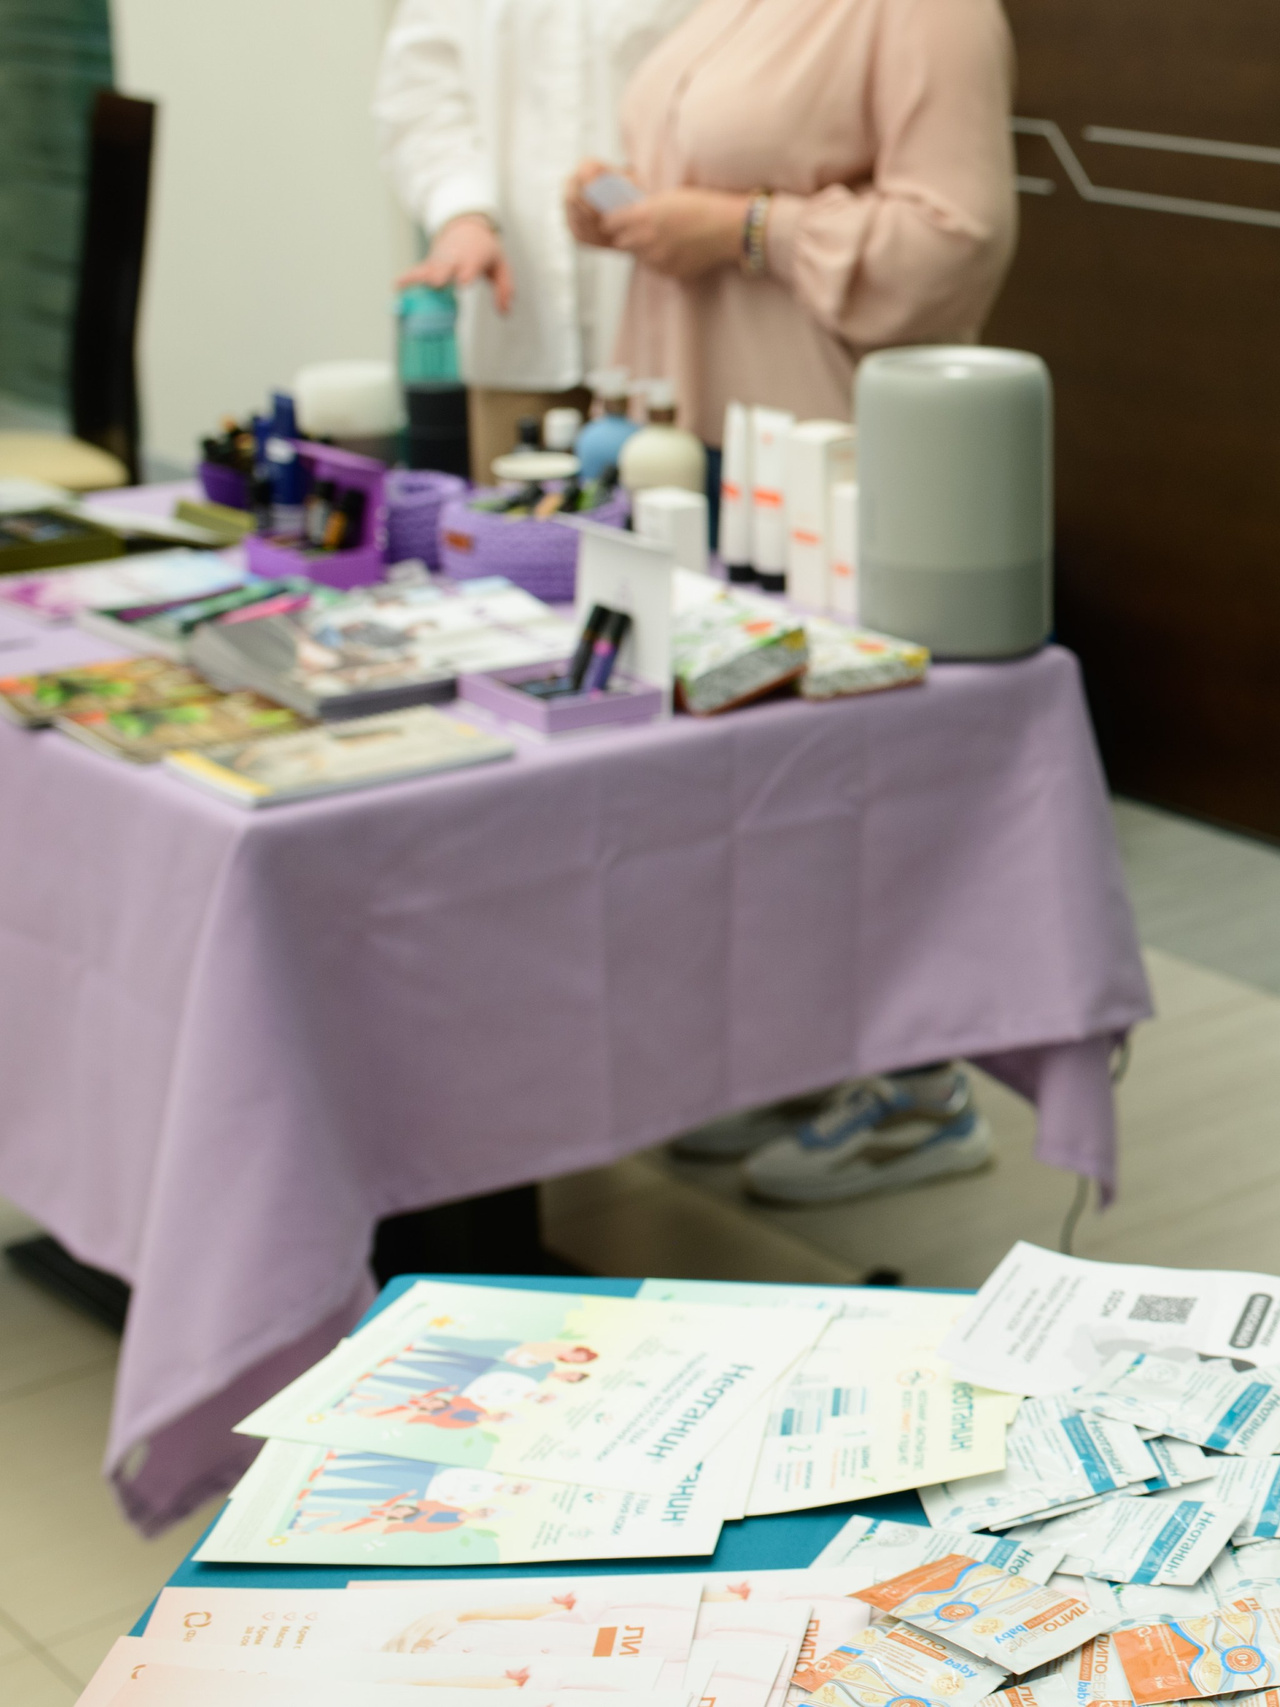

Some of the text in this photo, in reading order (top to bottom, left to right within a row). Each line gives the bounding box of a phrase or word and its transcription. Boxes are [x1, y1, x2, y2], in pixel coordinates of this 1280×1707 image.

[1164, 1510, 1216, 1578] Неотанин
[1007, 1548, 1034, 1576] Нео
[618, 1625, 645, 1658] ЛИ
[993, 1624, 1027, 1645] baby
[943, 1657, 978, 1679] baby
